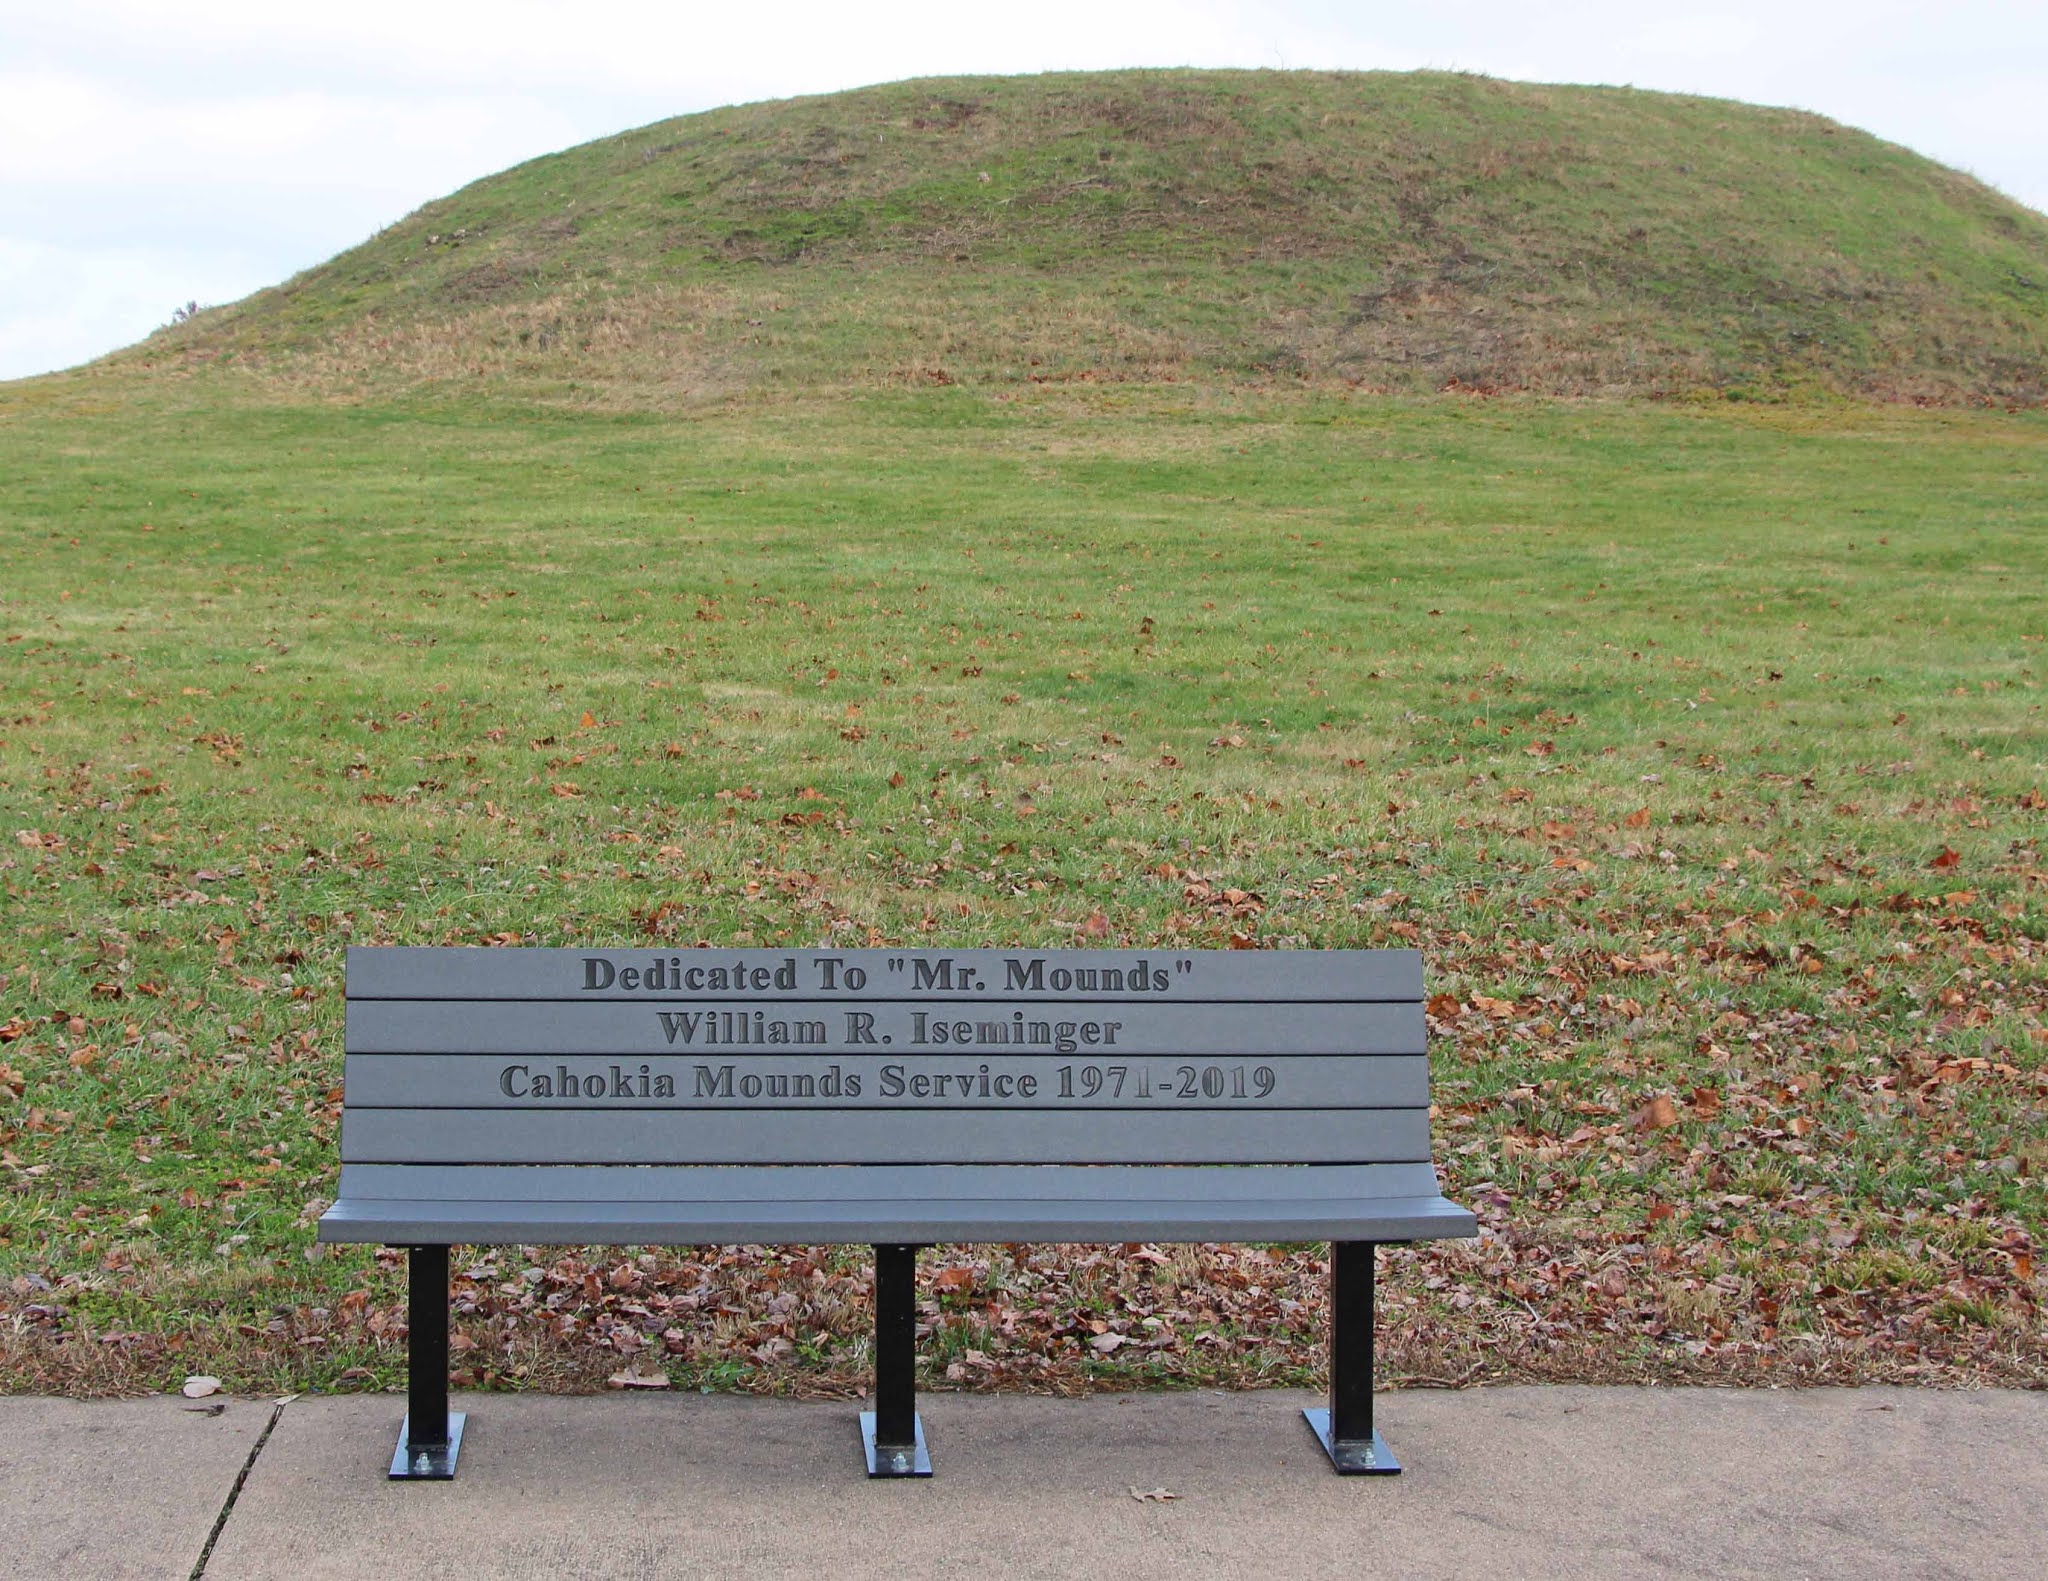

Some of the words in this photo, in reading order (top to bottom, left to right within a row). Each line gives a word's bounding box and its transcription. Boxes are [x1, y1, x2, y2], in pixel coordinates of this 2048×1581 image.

[582, 957, 797, 991] Dedicated
[814, 958, 867, 991] To
[888, 957, 985, 992] "Mr.
[1004, 958, 1192, 993] Mounds"
[656, 1010, 827, 1045] William
[844, 1011, 892, 1045] R.
[911, 1011, 1122, 1052] Iseminger
[500, 1064, 676, 1098] Cahokia
[693, 1065, 862, 1099] Mounds
[879, 1063, 1038, 1099] Service
[1057, 1065, 1276, 1099] 1971-2019
